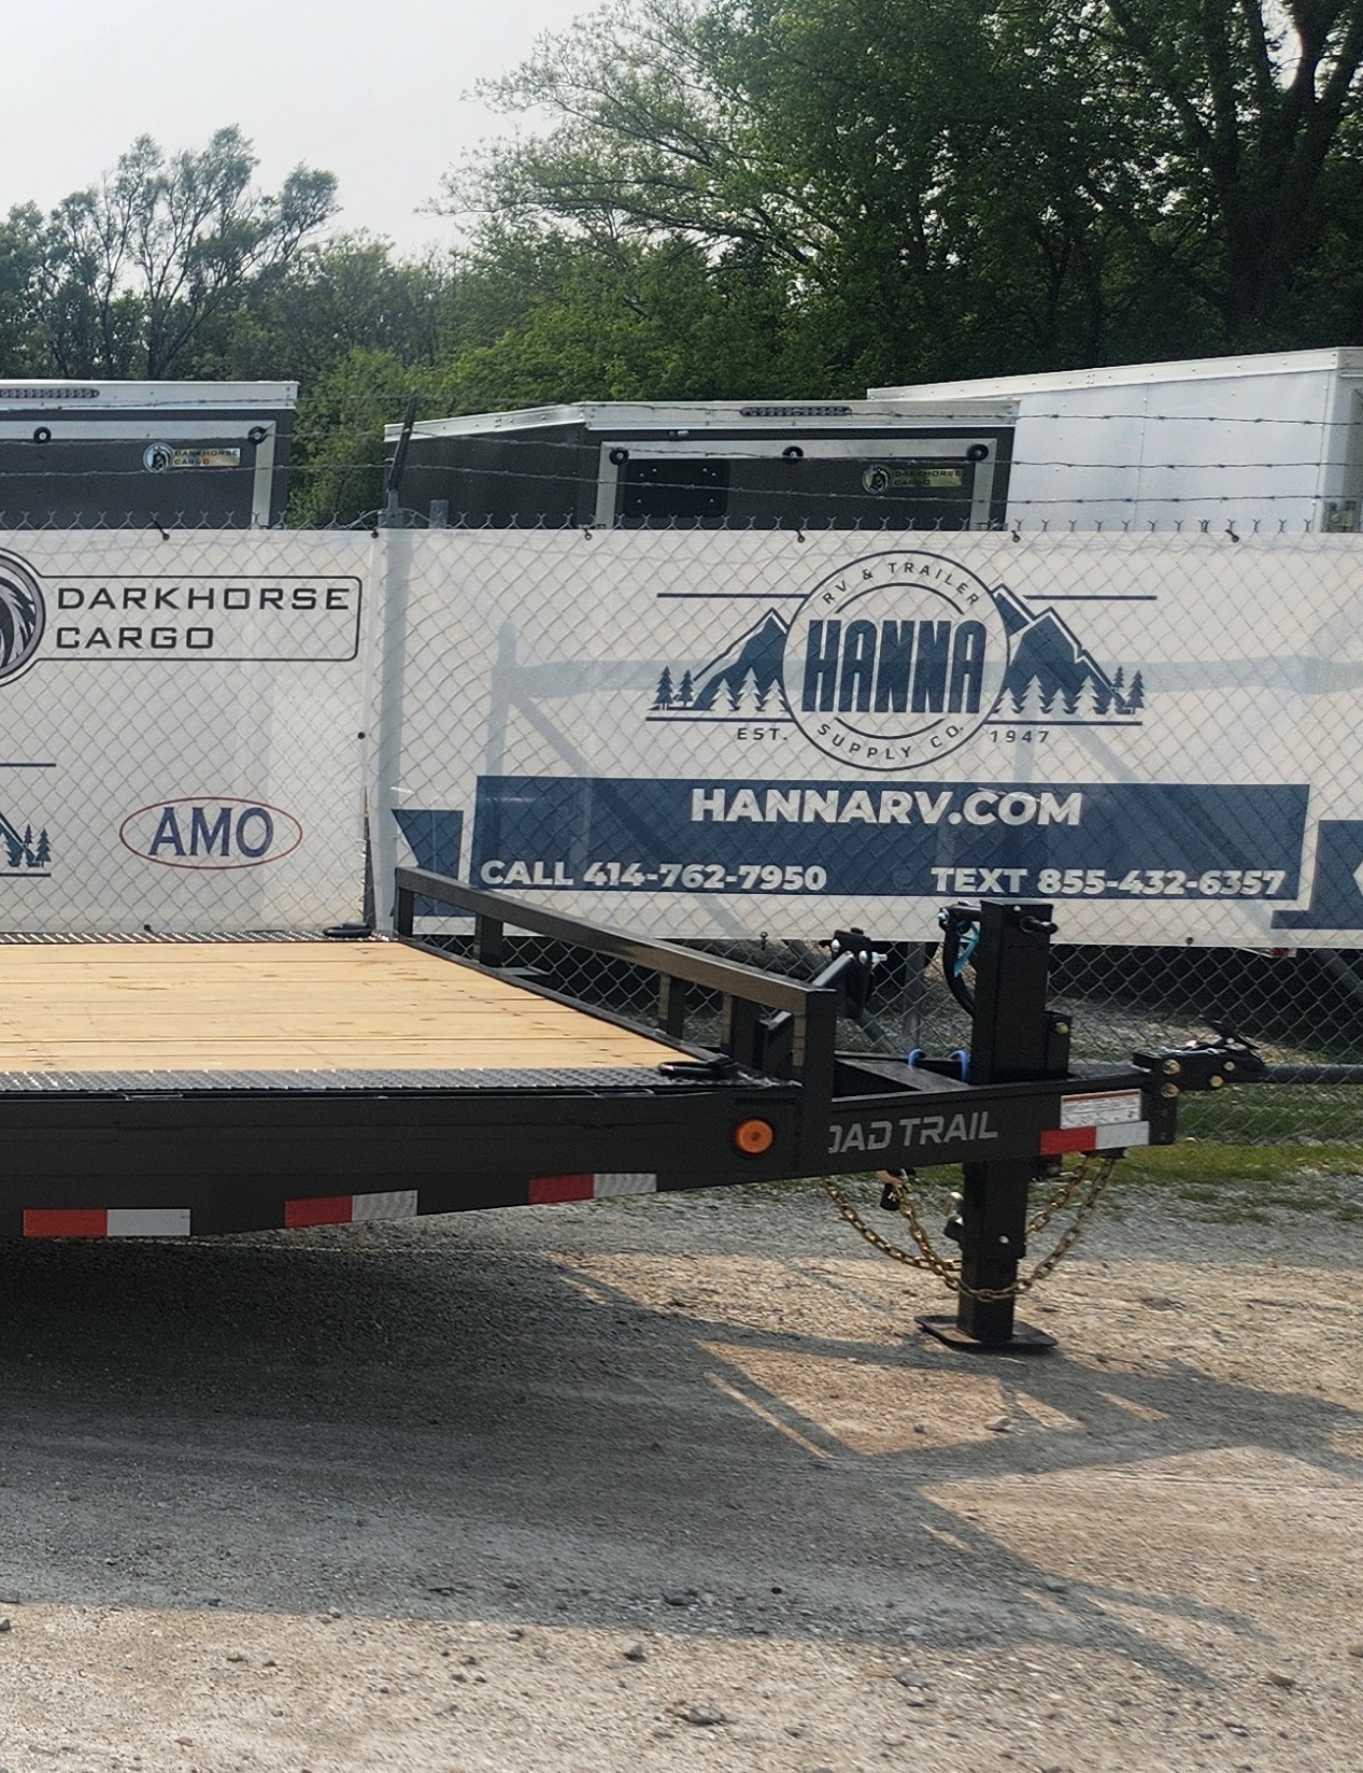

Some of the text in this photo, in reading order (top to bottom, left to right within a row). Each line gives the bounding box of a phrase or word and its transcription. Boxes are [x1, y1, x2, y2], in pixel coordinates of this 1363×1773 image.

[57, 587, 350, 610] DARKHORSE
[822, 561, 980, 606] RV & TRAILER
[55, 626, 215, 650] CARGO
[801, 619, 988, 713] HANNA
[736, 727, 788, 741] EST.
[816, 722, 965, 761] SUPPLY CO.
[989, 730, 1051, 744] 1947
[690, 790, 1083, 824] HANNARV.COM
[147, 806, 275, 858] AMO
[480, 859, 827, 891] CALL 414-762-7950
[930, 867, 1287, 897] TEXT 855-432-6357
[898, 1110, 999, 1147] TRAIL
